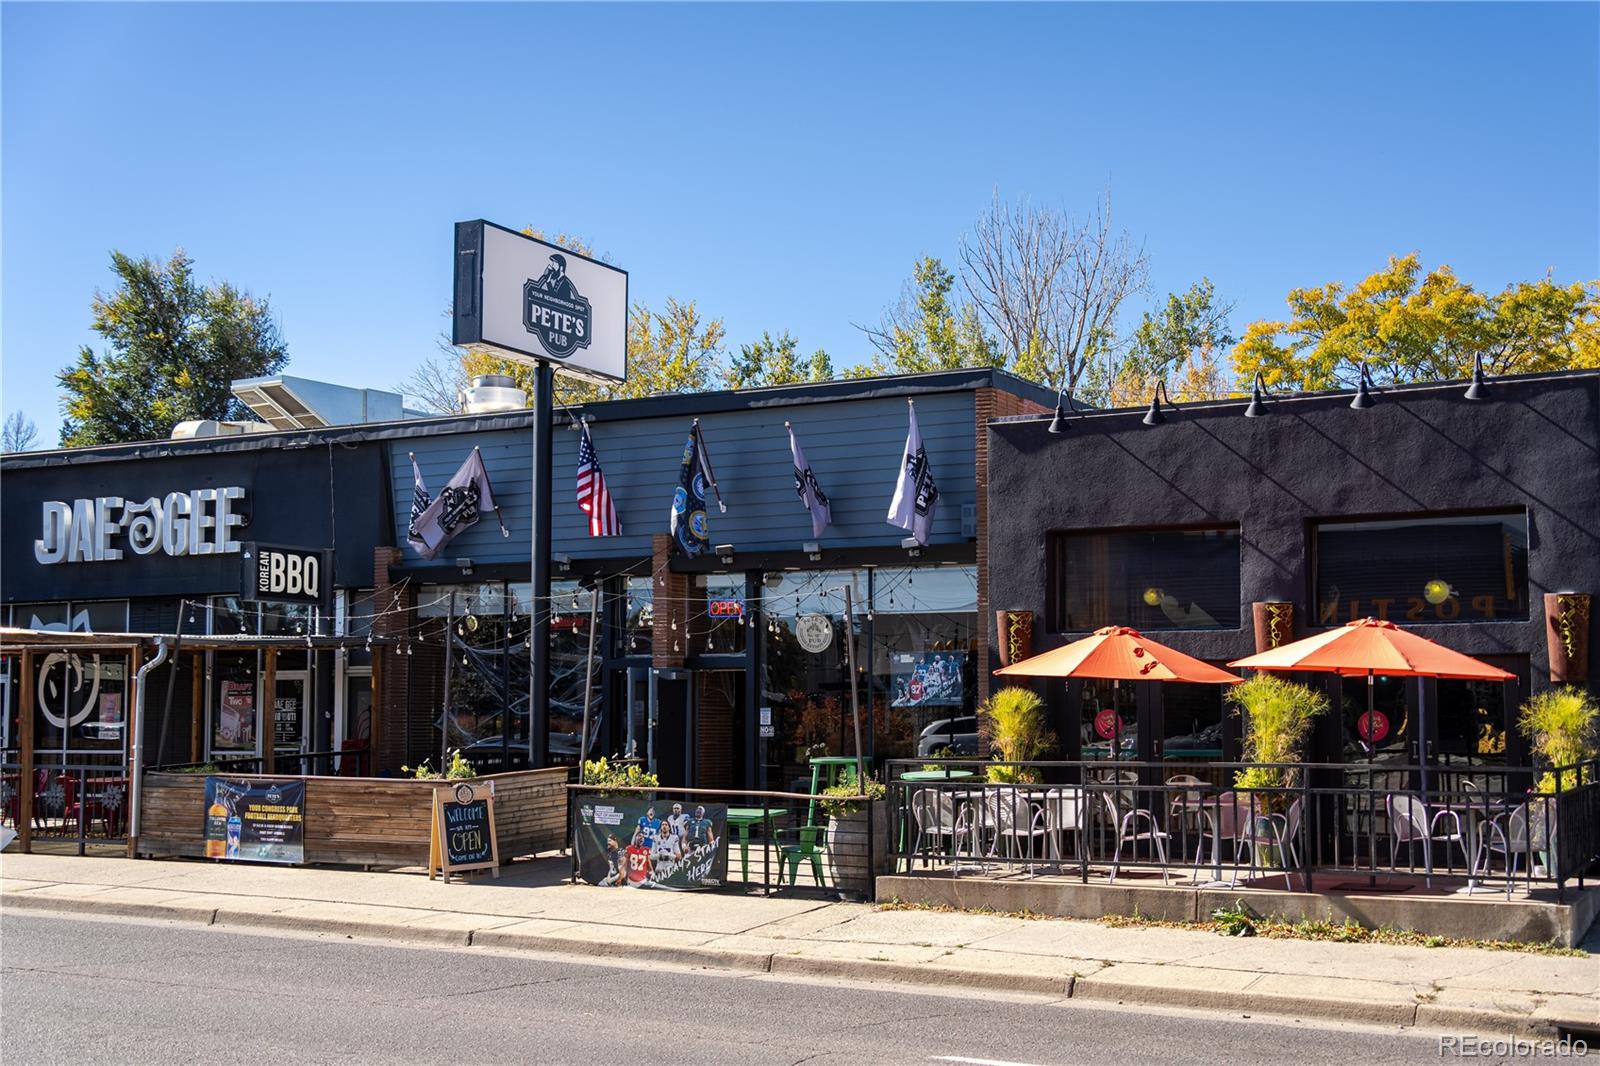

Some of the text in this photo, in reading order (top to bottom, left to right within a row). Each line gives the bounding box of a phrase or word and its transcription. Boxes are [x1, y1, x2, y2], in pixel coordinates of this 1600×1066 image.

[531, 303, 585, 337] PETE'S
[548, 331, 568, 347] PUB
[34, 487, 246, 565] DAE GEE
[259, 551, 270, 592] KOREAN
[270, 552, 319, 598] BBQ
[711, 601, 742, 615] OPEN
[447, 806, 484, 823] WELCOME
[452, 830, 482, 852] OPEN
[694, 836, 721, 862] START
[630, 854, 647, 871] 87
